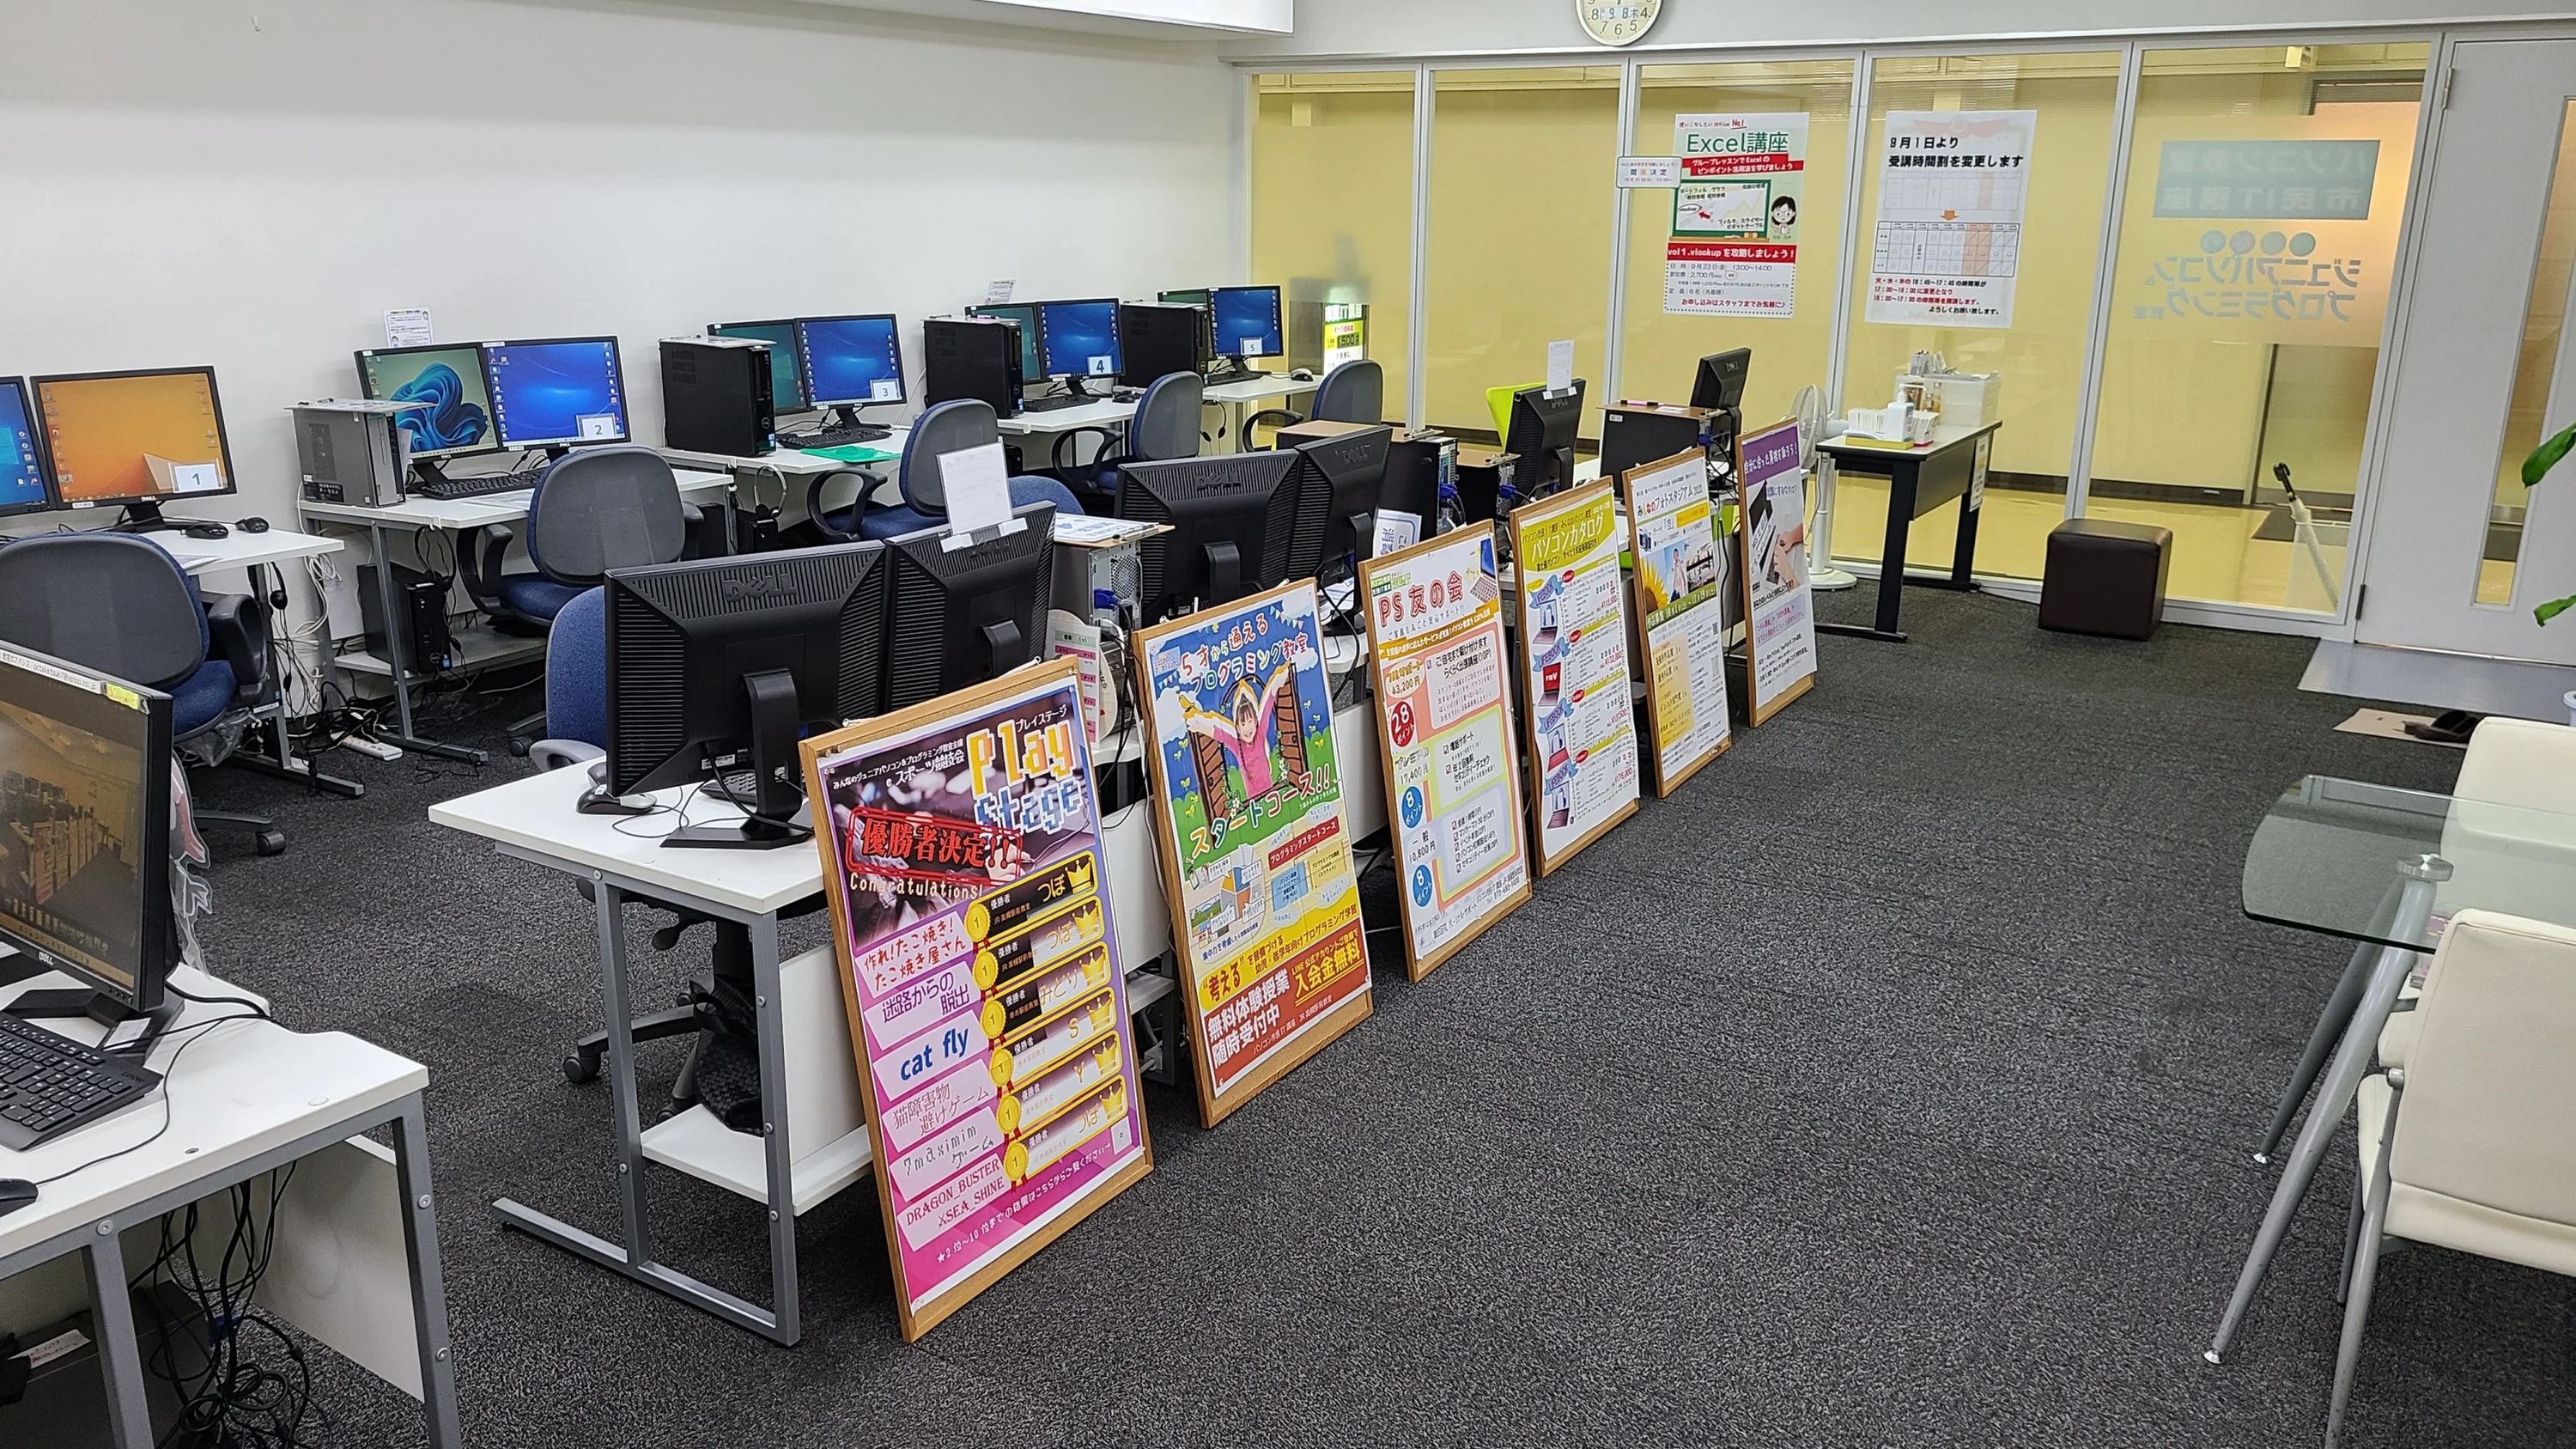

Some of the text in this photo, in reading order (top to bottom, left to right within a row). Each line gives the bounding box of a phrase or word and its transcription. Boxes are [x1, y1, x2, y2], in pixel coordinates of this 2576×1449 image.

[1591, 9, 1599, 21] 8
[1640, 7, 1648, 18] 4
[1601, 21, 1608, 32] 7
[1614, 23, 1622, 35] 6
[1630, 20, 1637, 31] 5
[1686, 131, 1789, 153] Excel講座
[1890, 137, 1959, 149] 9月1日より
[1888, 155, 2023, 168] 受講時間割を変更します
[1249, 343, 1256, 352] 5
[1096, 360, 1106, 374] 4
[881, 387, 889, 398] 3
[593, 423, 604, 436] 2
[191, 472, 202, 487] 1
[1532, 512, 1605, 563] パソコンカタログ
[723, 573, 798, 602] DELL
[1378, 570, 1463, 628] PS友の会
[1181, 613, 1269, 678] 5才から通える
[1190, 633, 1309, 695] プログラミング教室
[1015, 704, 1067, 733] プレイステージ
[1391, 703, 1410, 733] 28
[1397, 723, 1415, 746] ポイント
[967, 719, 1073, 798] Play
[1406, 790, 1415, 808] 8
[1188, 763, 1332, 861] スタートコース!!
[861, 817, 1011, 871] 優勝者決定!!
[1269, 819, 1338, 865] プログラミングスタートコース
[1037, 873, 1066, 903] つぼ
[1417, 868, 1425, 886] 8
[990, 894, 1011, 910] 優勝者
[864, 918, 955, 971] 作れ!たこ焼き!
[998, 941, 1018, 959] 優勝者
[39, 952, 55, 966] DELL
[873, 940, 967, 991] たこ焼き屋さん
[1294, 938, 1361, 998] 入会金無料
[881, 971, 955, 1023] 迷路からの
[940, 983, 970, 1016] 脱出
[1005, 989, 1026, 1007] 優勝者
[1206, 968, 1291, 1042] 無料体験授業
[1068, 1017, 1080, 1039] S
[1212, 1006, 1280, 1069] 随時受付中
[900, 1026, 969, 1081] cat fly
[1014, 1037, 1035, 1055] 優勝者
[1073, 1061, 1085, 1083] Y
[1021, 1083, 1042, 1101] 優勝者
[892, 1082, 951, 1129] 猫障害物
[920, 1086, 991, 1138] 避けゲーム
[1029, 1129, 1049, 1148] 優勝者
[951, 1135, 994, 1170] ゲーム
[905, 1157, 1001, 1227] DRAGON_BUSTER
